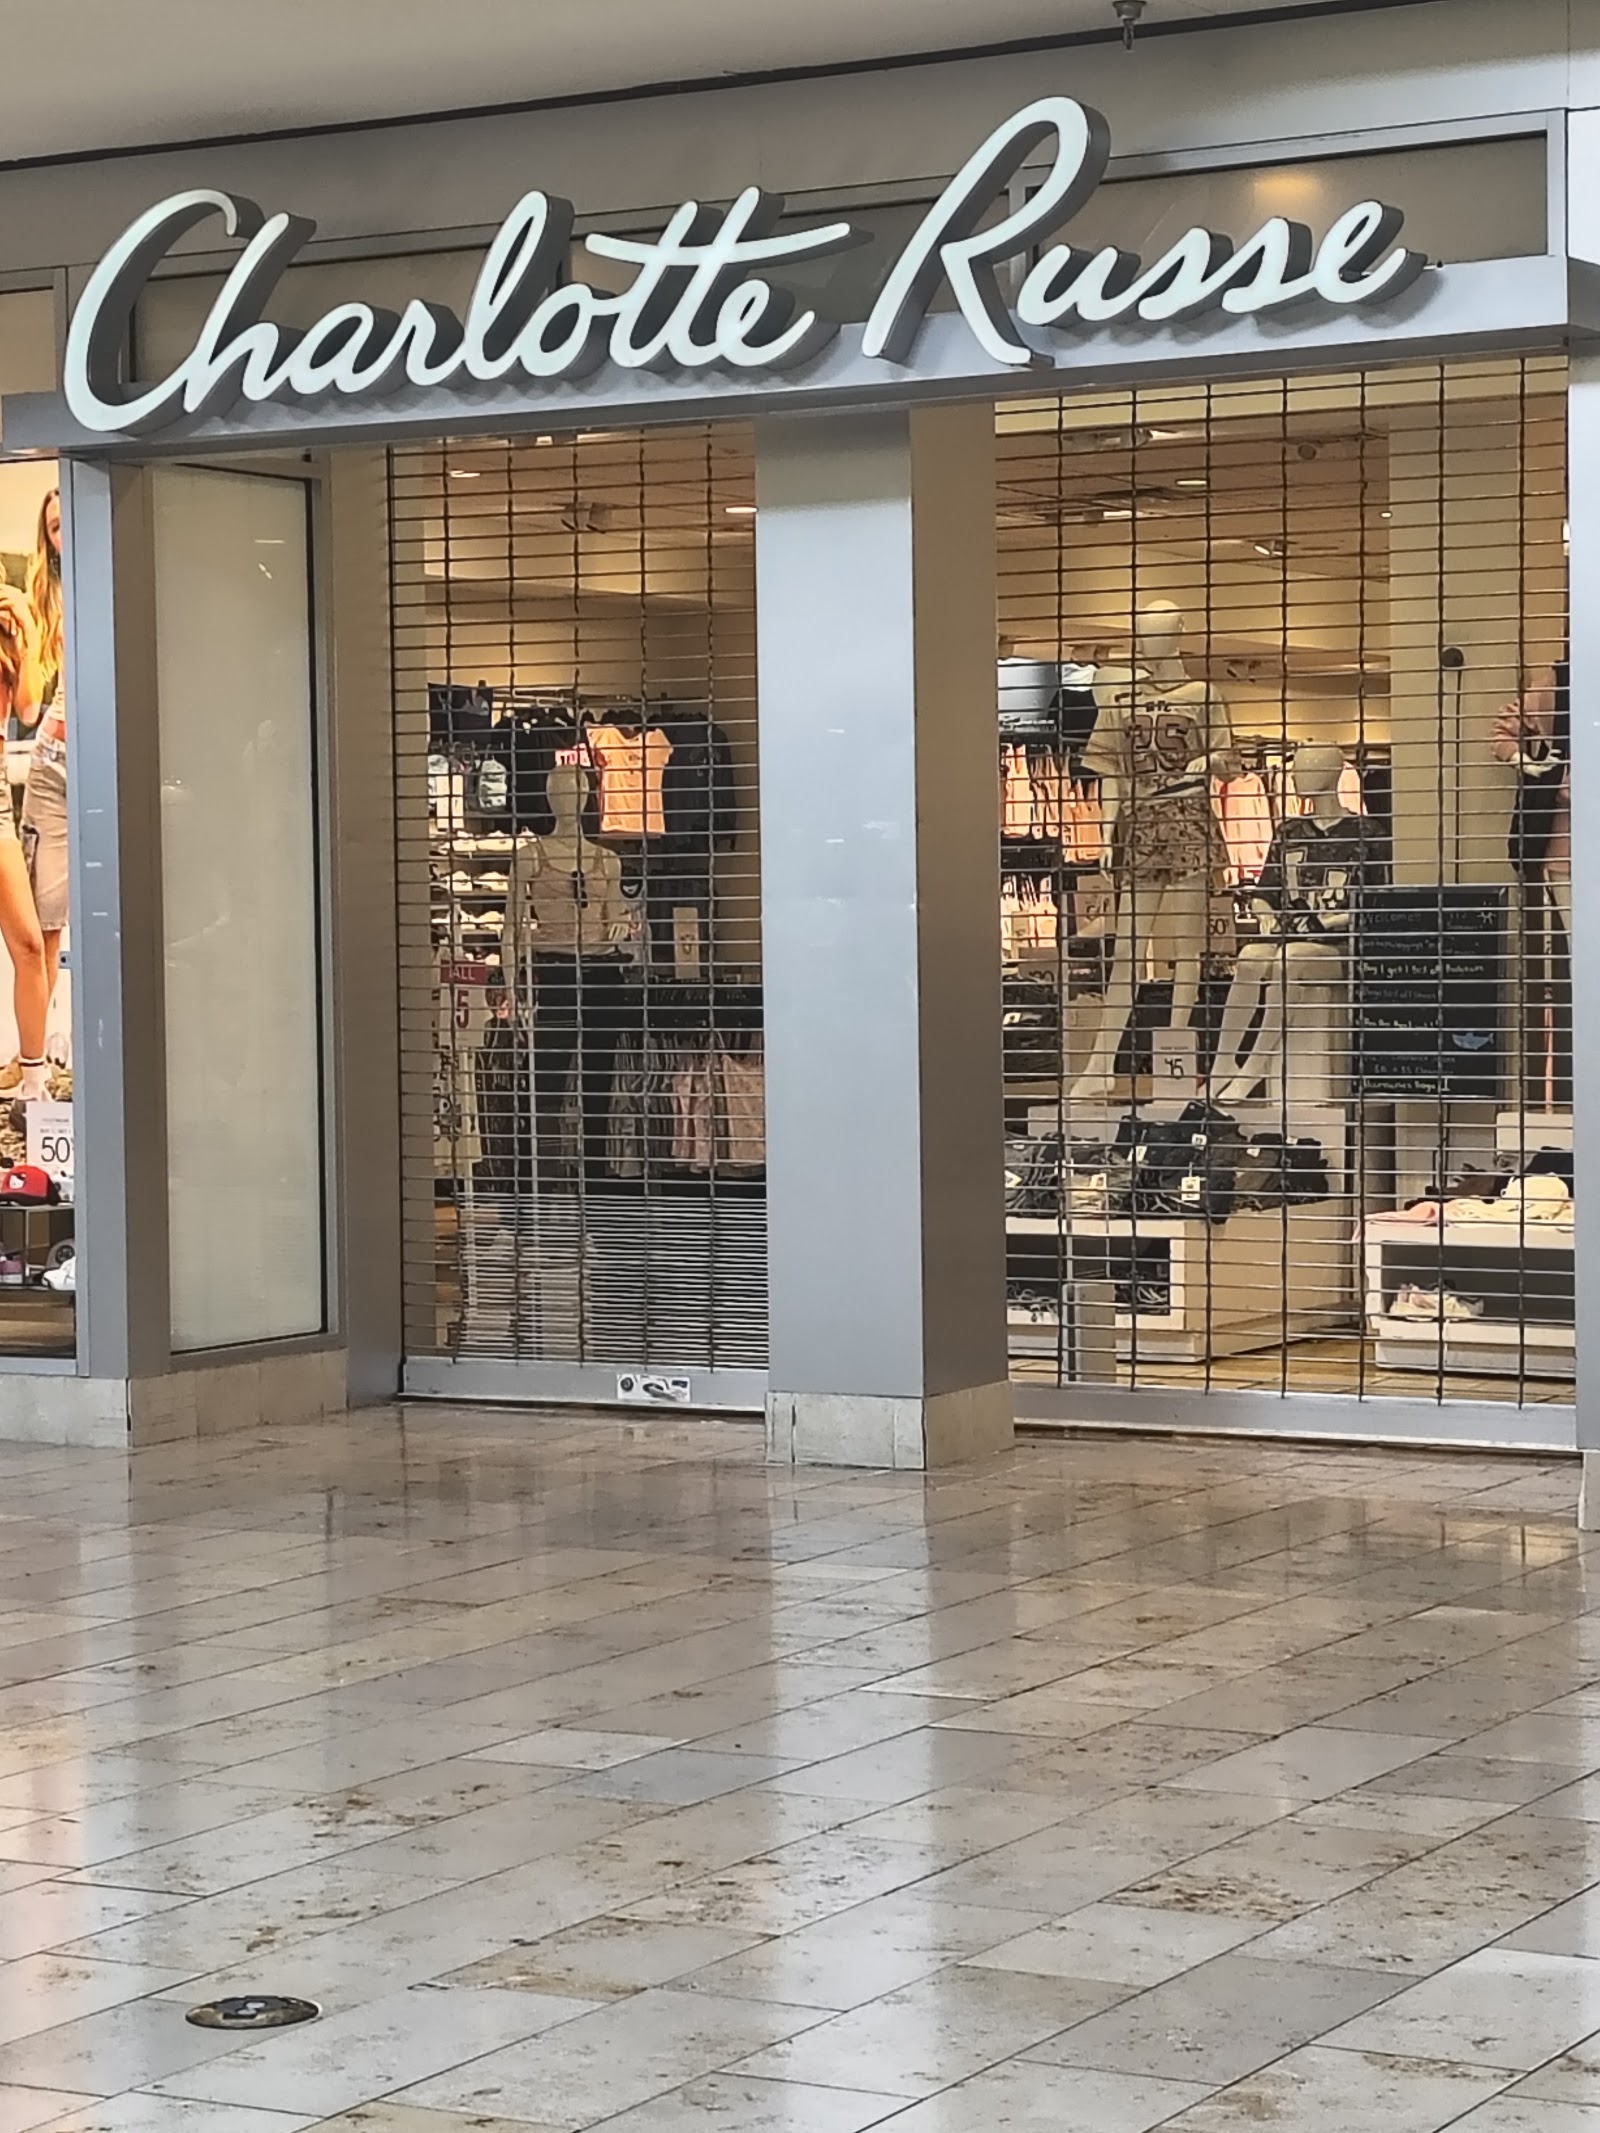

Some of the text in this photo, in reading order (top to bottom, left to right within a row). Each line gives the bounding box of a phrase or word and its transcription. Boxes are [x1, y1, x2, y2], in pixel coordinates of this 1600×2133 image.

[64, 96, 1413, 433] Charlotte Russe
[41, 1135, 74, 1163] 50
